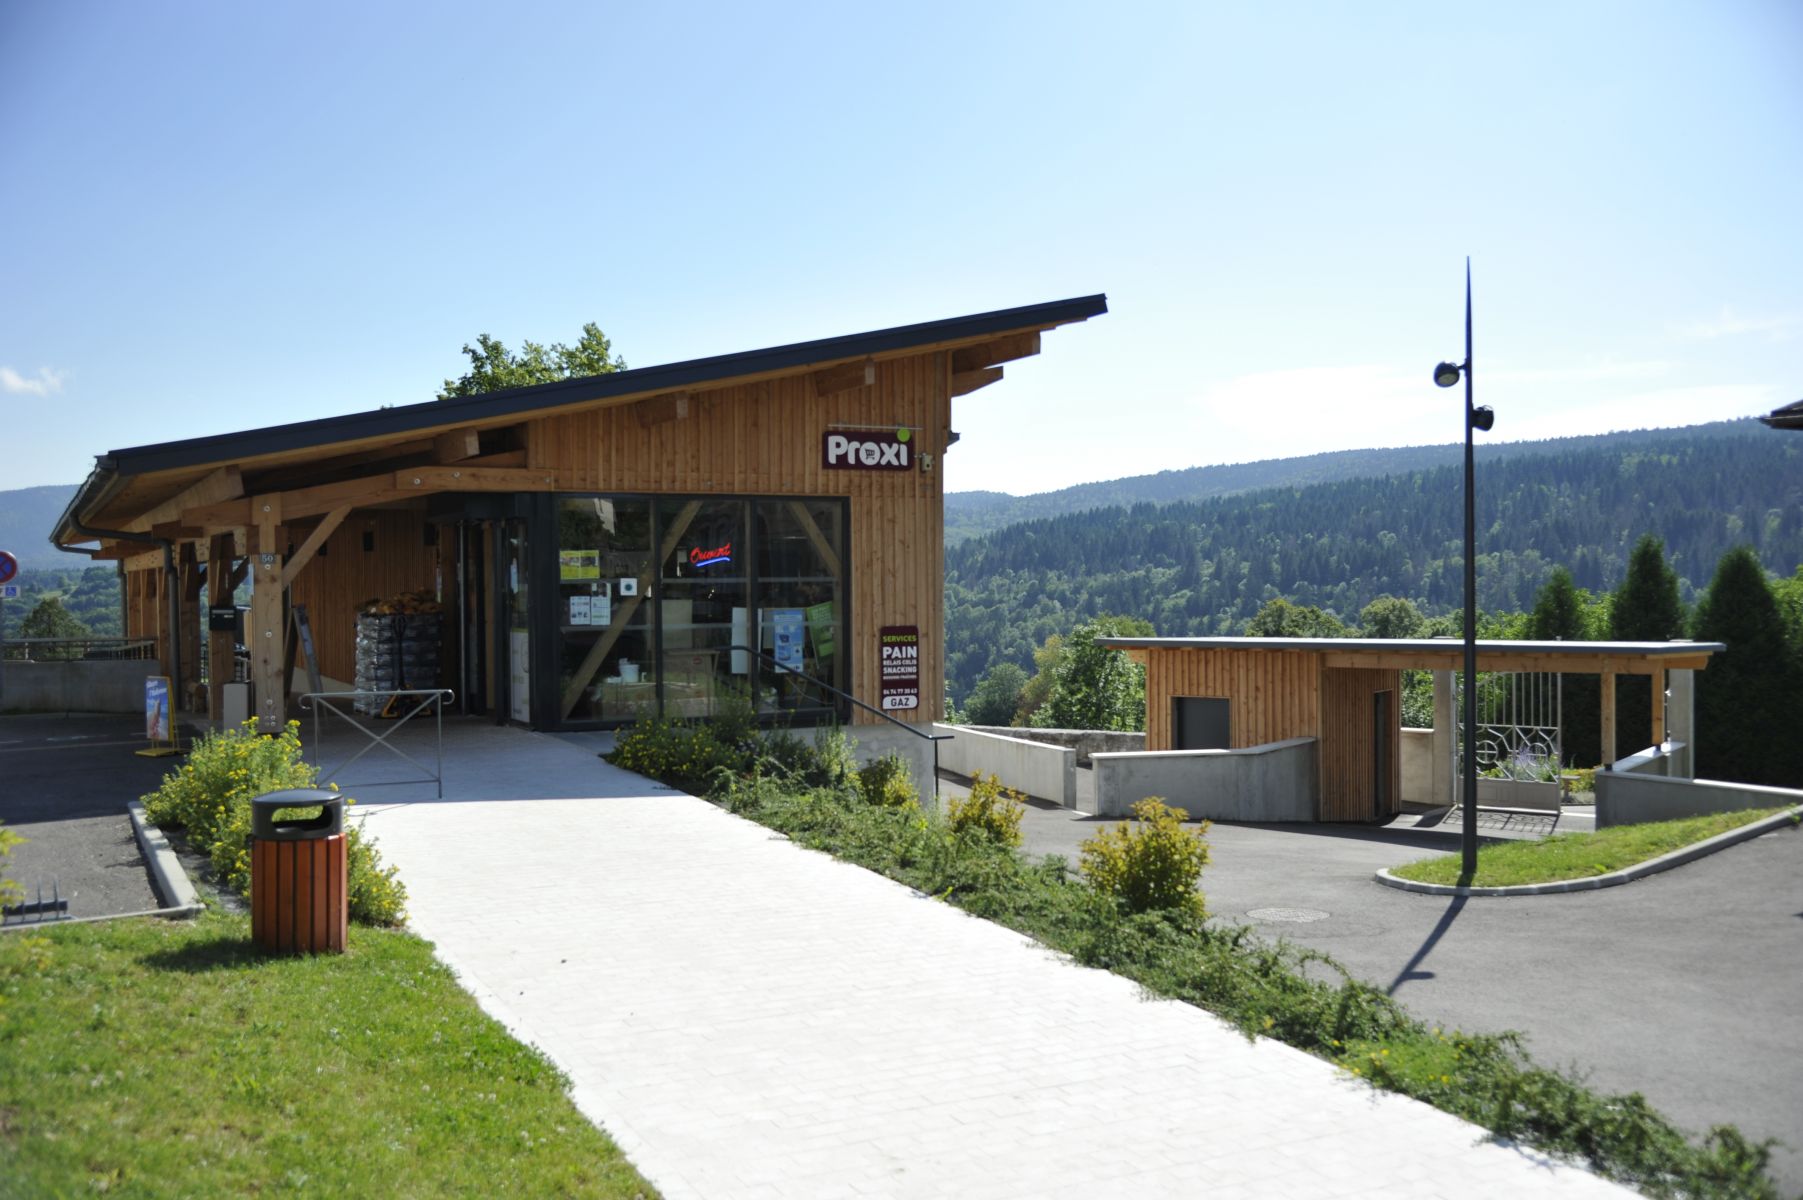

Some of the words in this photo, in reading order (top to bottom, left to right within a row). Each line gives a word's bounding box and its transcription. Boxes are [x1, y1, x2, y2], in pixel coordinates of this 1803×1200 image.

[828, 428, 910, 466] Proxi
[883, 646, 917, 659] PAIN
[883, 666, 917, 674] SNACKING
[891, 698, 910, 706] GAZ
